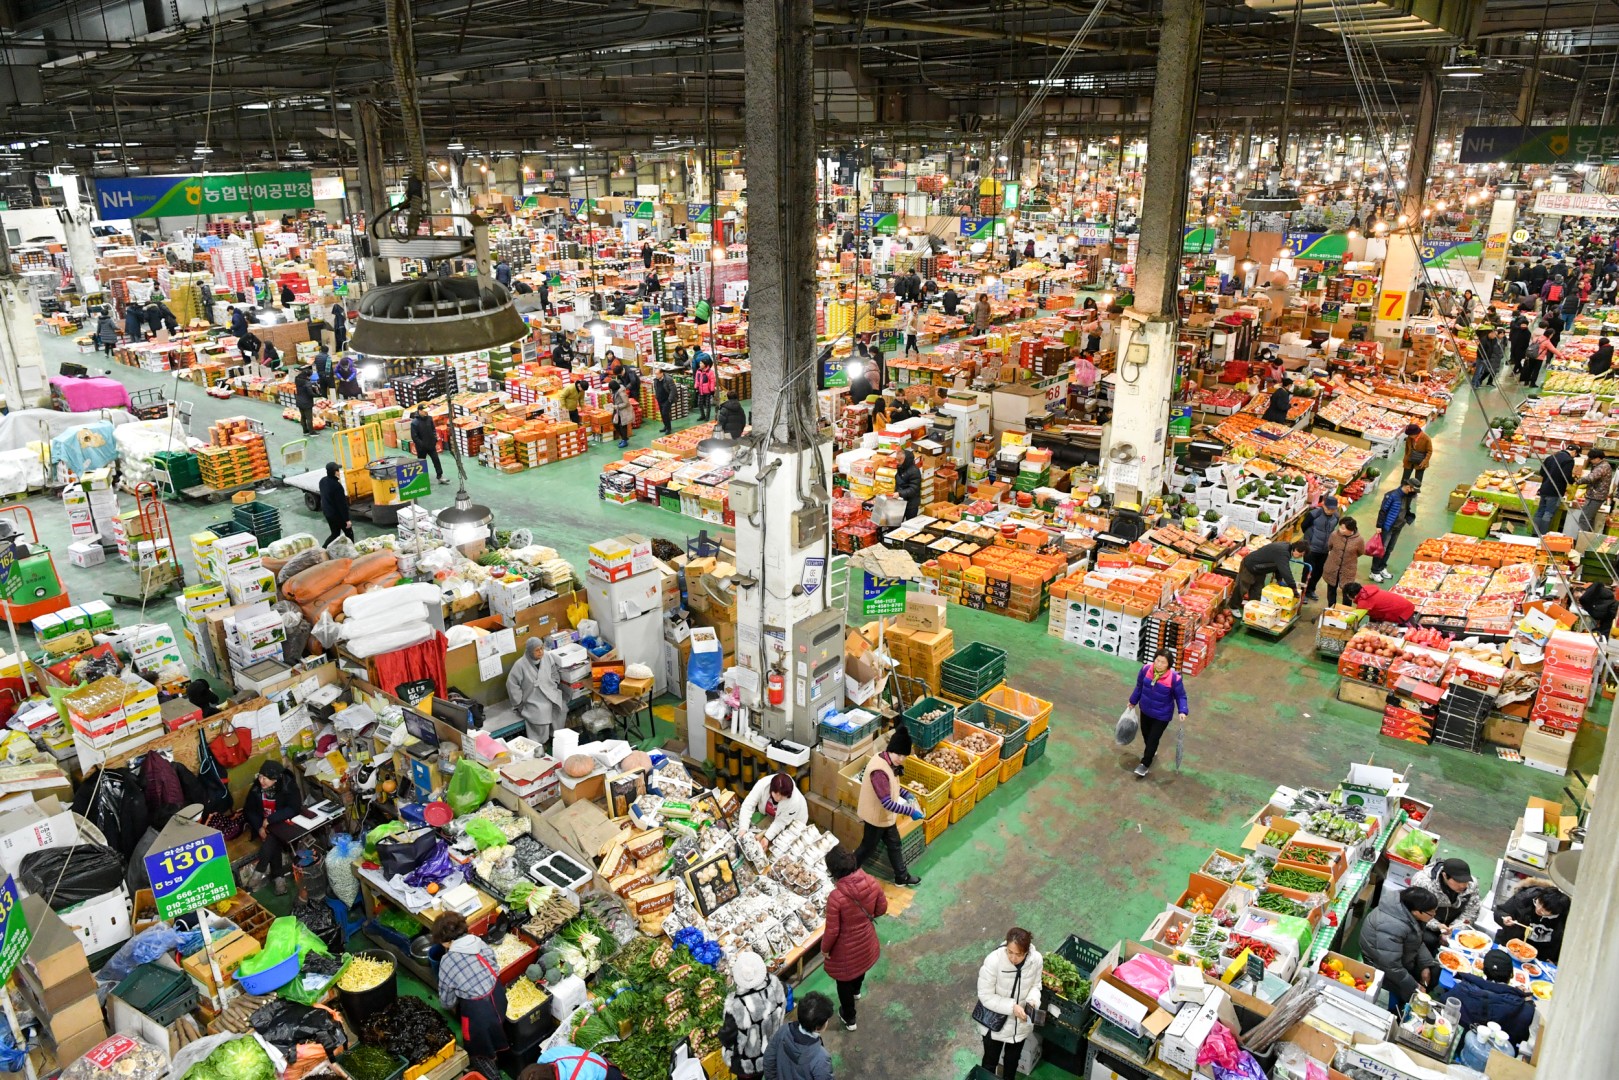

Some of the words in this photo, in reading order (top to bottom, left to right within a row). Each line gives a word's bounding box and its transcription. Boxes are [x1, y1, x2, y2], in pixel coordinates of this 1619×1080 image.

[1466, 138, 1494, 152] NH
[102, 191, 133, 208] NH
[205, 183, 311, 203] 농협반여공판장
[625, 204, 635, 213] 50
[688, 208, 700, 216] 22
[859, 217, 874, 226] 53
[964, 222, 977, 232] 3
[1515, 232, 1526, 241] 마
[1356, 283, 1368, 297] 9
[1327, 303, 1337, 311] 17
[1384, 294, 1402, 317] 7
[1141, 455, 1146, 463] 6
[401, 465, 424, 478] 172
[160, 844, 214, 875] 130
[166, 884, 229, 911] 010-3837-1851
[176, 882, 215, 900] 666-1130
[168, 890, 230, 918] 010-3850-1851
